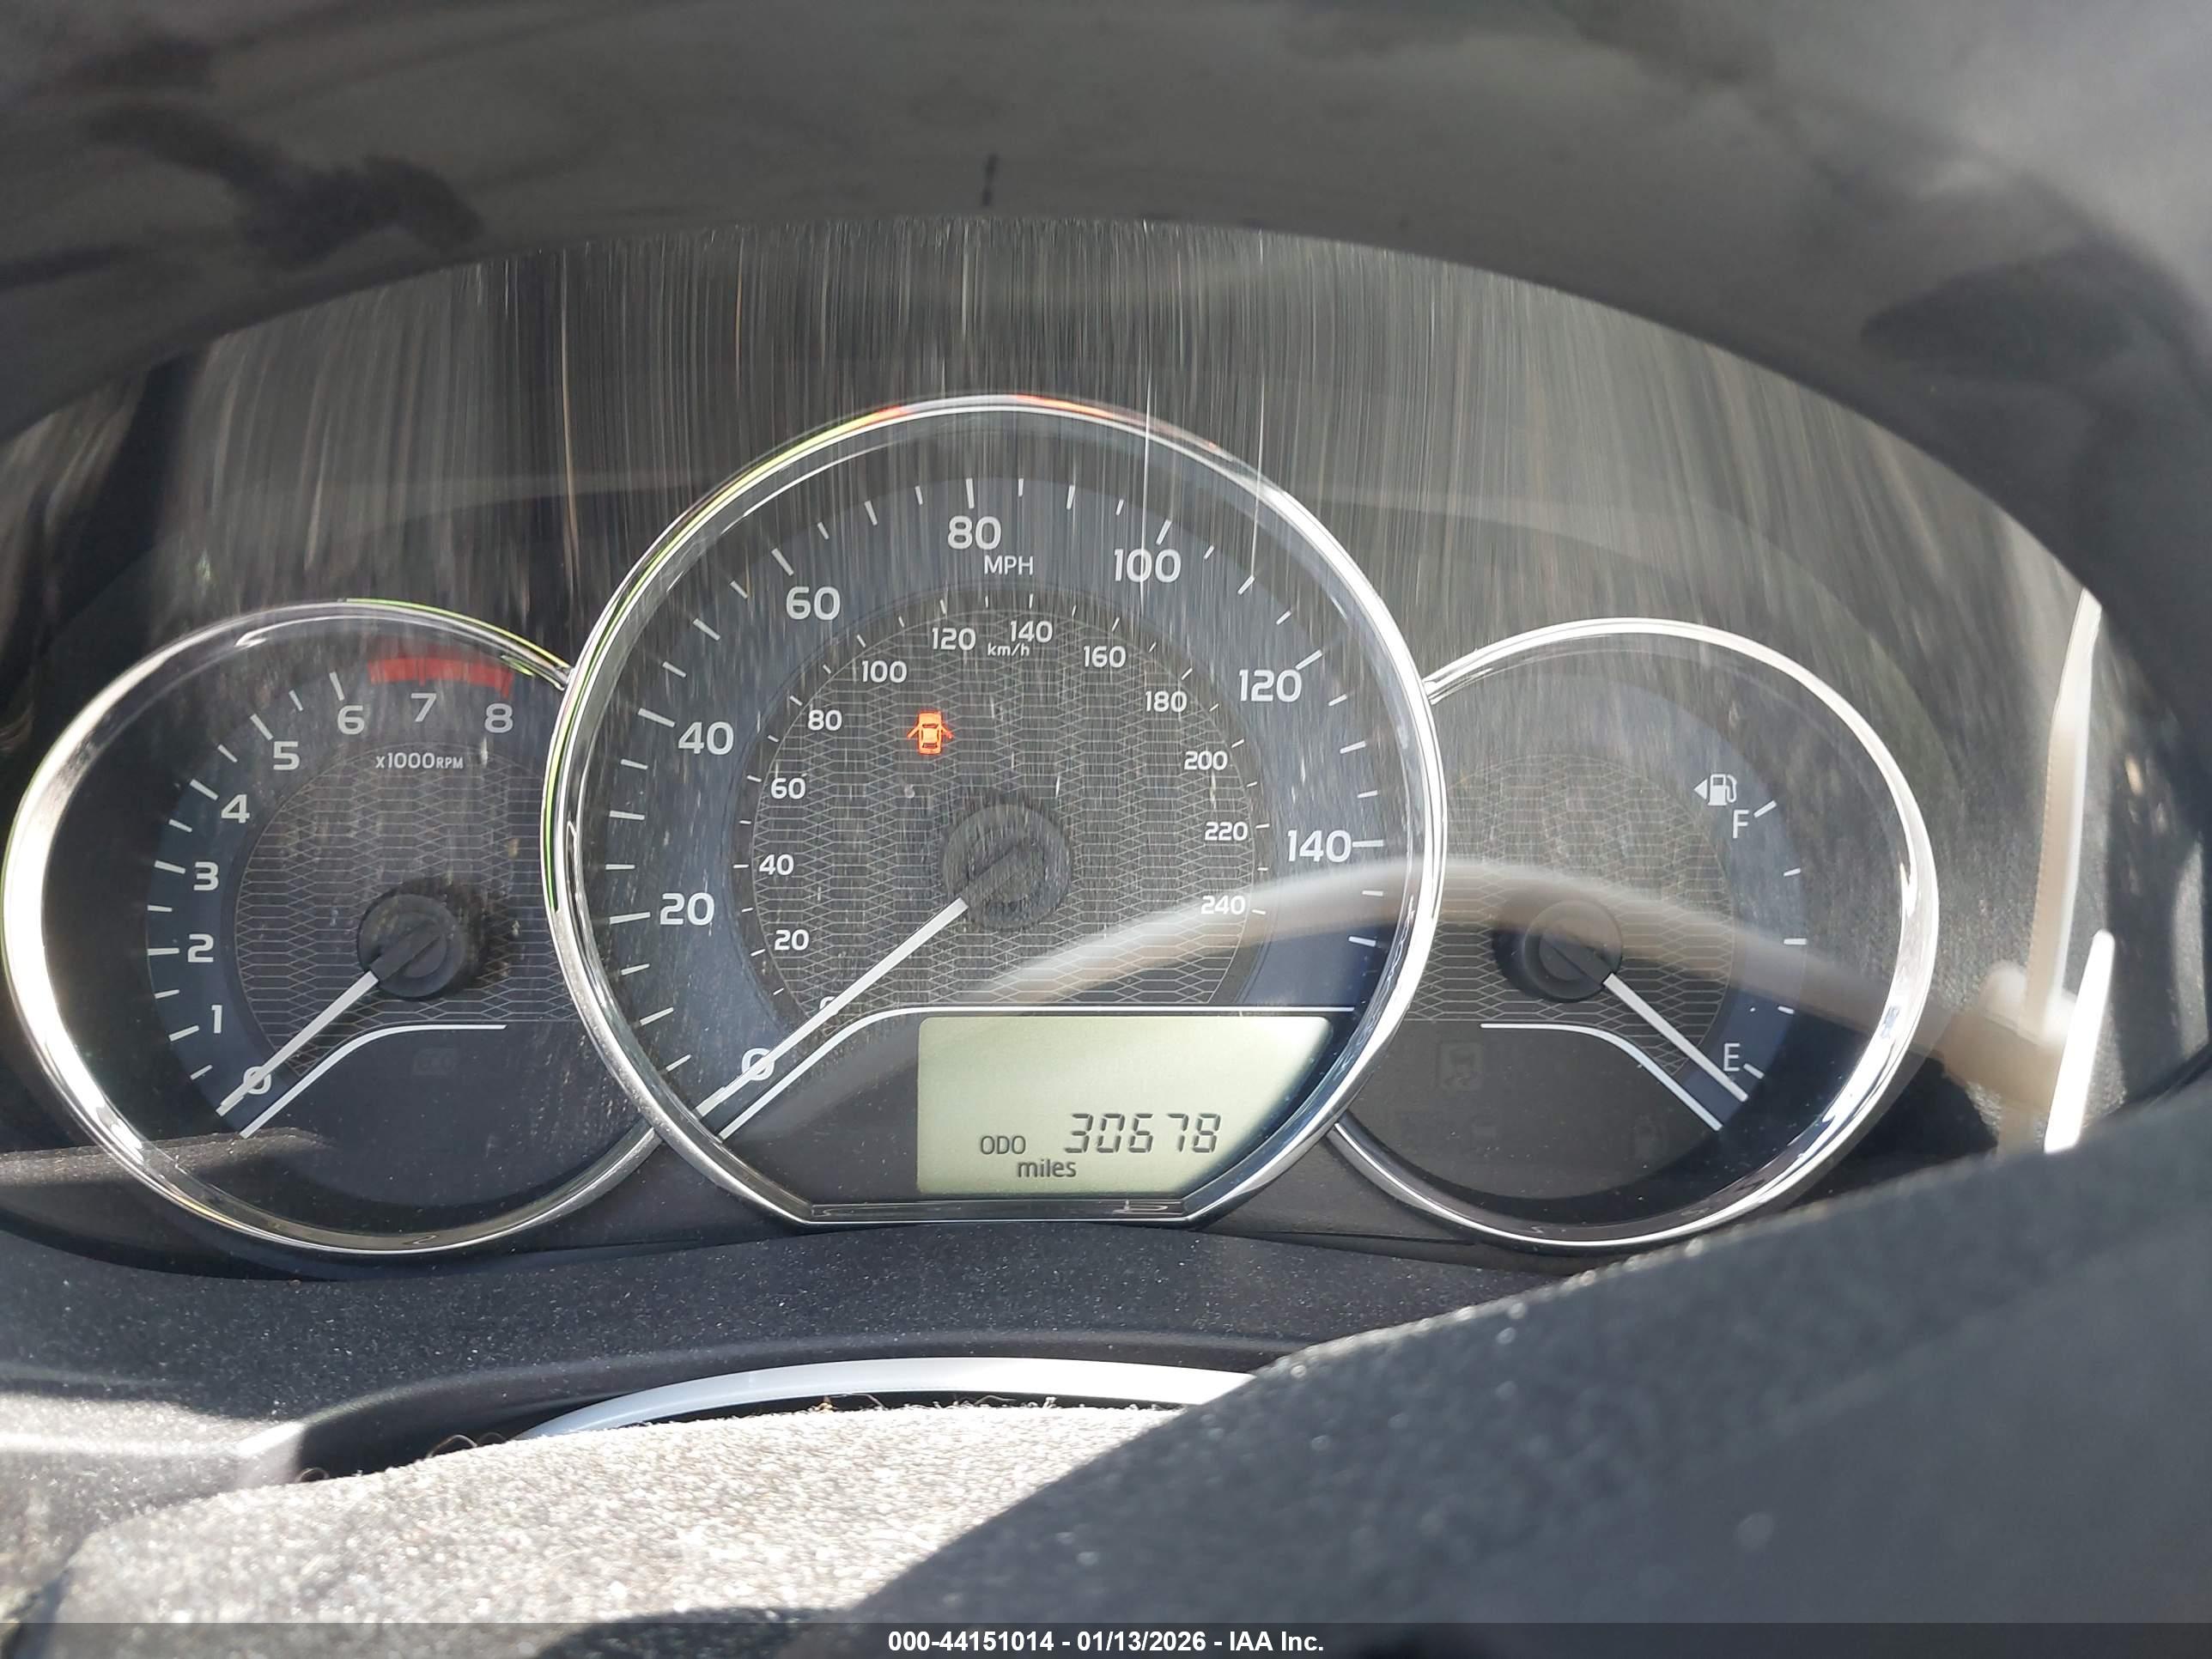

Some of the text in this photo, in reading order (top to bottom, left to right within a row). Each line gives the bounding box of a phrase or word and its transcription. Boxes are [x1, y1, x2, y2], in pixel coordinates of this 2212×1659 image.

[947, 516, 1001, 550] 80
[984, 556, 1034, 576] MPH
[1115, 549, 1181, 583] 100
[786, 586, 841, 620] 60
[932, 628, 976, 650] 120
[1011, 621, 1053, 642] 140
[988, 642, 1030, 656] km/h
[1084, 646, 1126, 668] 160
[861, 660, 907, 684] 100
[1239, 670, 1302, 702] 120
[411, 693, 436, 722] 7
[1146, 691, 1188, 712] 180
[337, 706, 365, 734] 6
[484, 703, 514, 732] 8
[808, 709, 842, 731] 80
[678, 722, 734, 756] 40
[273, 741, 300, 770] 5
[1184, 750, 1229, 771] 200
[771, 777, 806, 799] 60
[221, 795, 250, 823] 4
[1205, 822, 1248, 842] 220
[1732, 810, 1749, 839] F
[1287, 830, 1352, 862] 140
[193, 862, 219, 890] 3
[758, 854, 794, 876] 40
[659, 893, 715, 926] 20
[1200, 896, 1245, 916] 240
[187, 933, 214, 963] 2
[775, 929, 810, 951] 20
[211, 1005, 222, 1033] 1
[741, 1048, 775, 1081] 0
[1723, 1043, 1741, 1072] E
[243, 1066, 271, 1094] 0
[980, 1113, 1221, 1155] ODO 30678
[1018, 1158, 1077, 1178] miles
